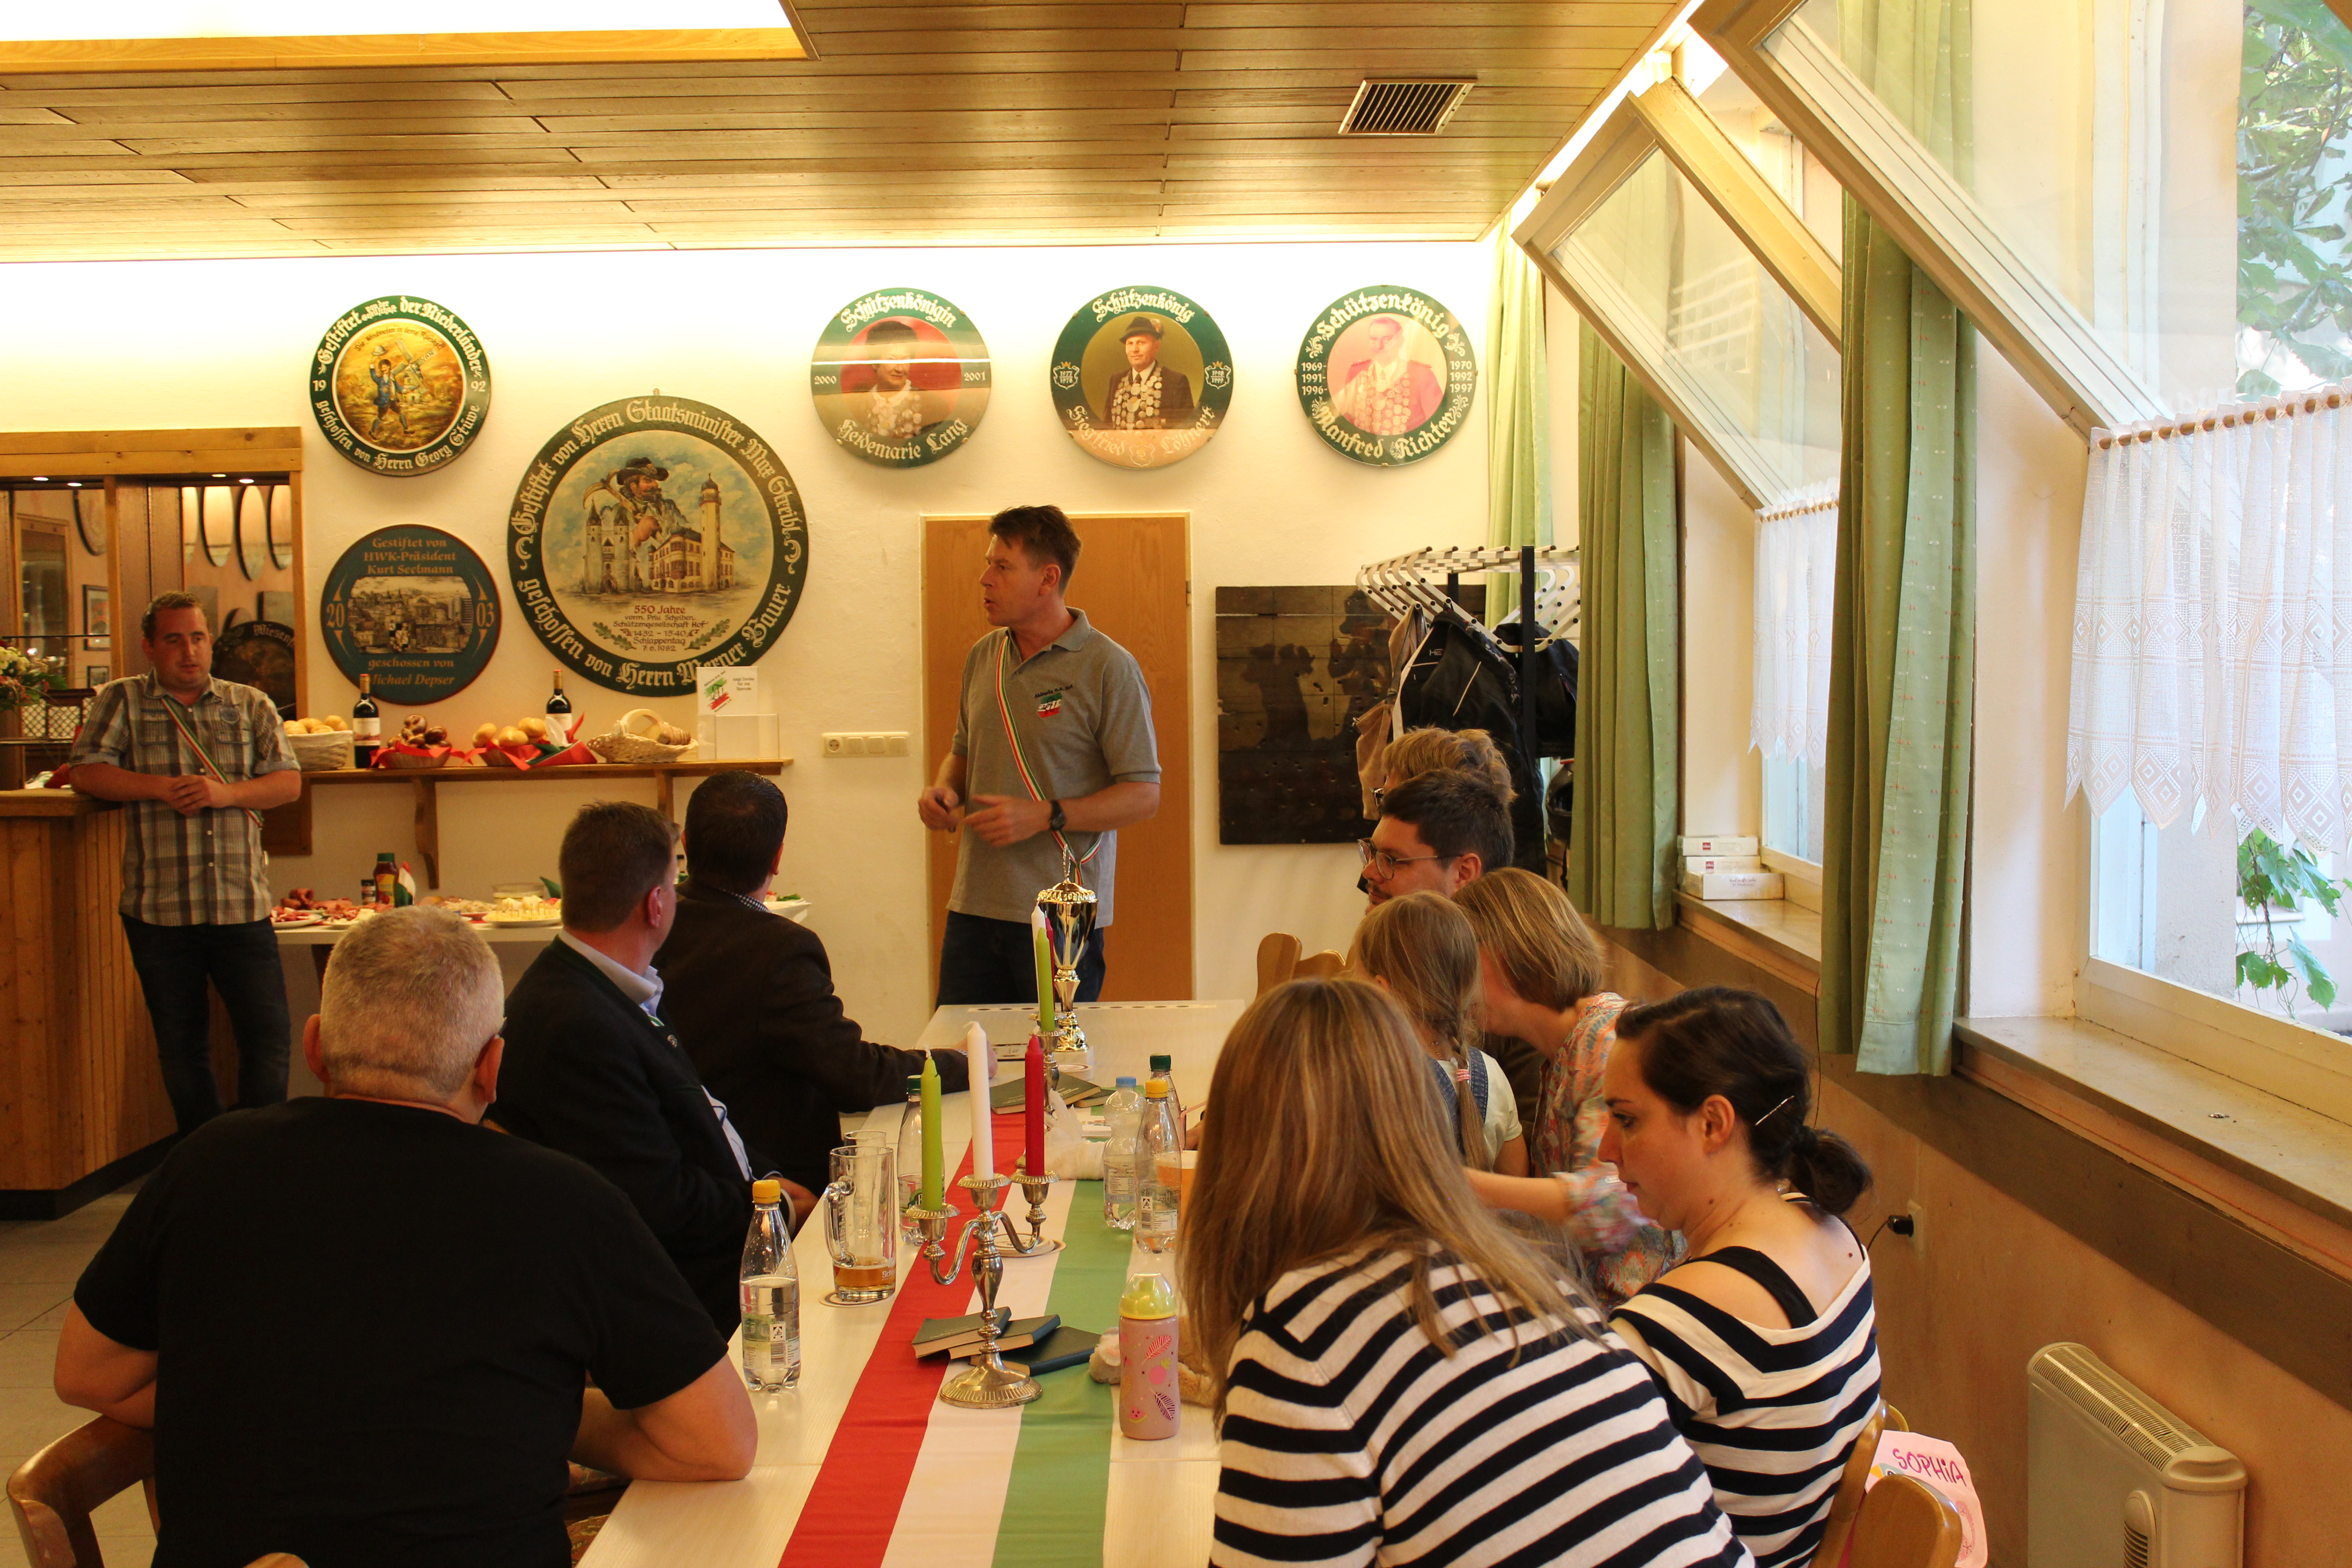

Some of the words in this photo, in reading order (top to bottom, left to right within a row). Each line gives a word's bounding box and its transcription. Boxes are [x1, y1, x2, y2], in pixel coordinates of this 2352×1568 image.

[1450, 361, 1472, 369] 1970
[814, 376, 837, 384] 2000
[964, 372, 986, 382] 2001
[1450, 372, 1472, 381] 1992
[313, 380, 326, 391] 19
[470, 381, 486, 392] 92
[1450, 383, 1473, 392] 1997
[372, 538, 423, 550] Gestiftet
[364, 551, 456, 561] HWK-Präsident
[367, 564, 395, 574] Kurt
[397, 564, 454, 574] Seelmann
[476, 602, 495, 627] 03
[634, 605, 655, 614] 550
[657, 605, 686, 614] Jahre
[326, 603, 345, 628] 20
[368, 657, 430, 670] geschossen
[414, 674, 456, 687] Depser
